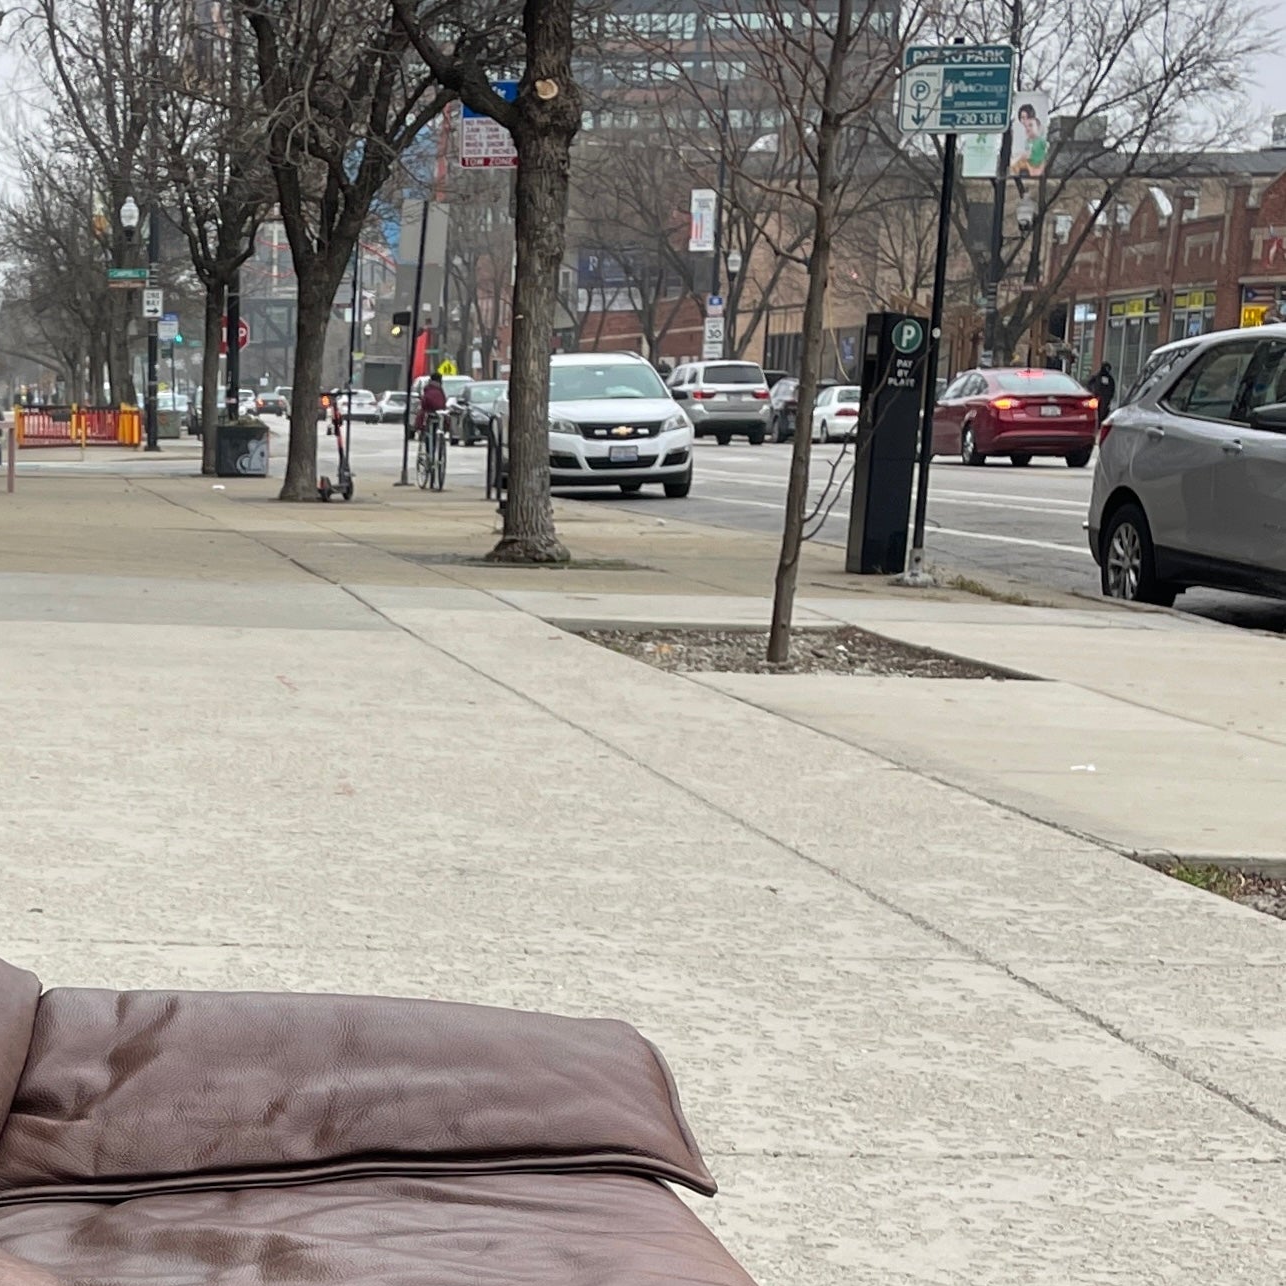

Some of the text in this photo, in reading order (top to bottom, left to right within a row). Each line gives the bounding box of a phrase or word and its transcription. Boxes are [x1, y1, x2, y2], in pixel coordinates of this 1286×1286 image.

[943, 50, 963, 63] TO
[966, 49, 1005, 63] PARK
[955, 113, 977, 124] 730
[465, 158, 514, 167] TOW ZONE
[707, 329, 722, 339] 30
[901, 325, 916, 347] P
[896, 359, 913, 369] PAY
[897, 369, 909, 377] BY
